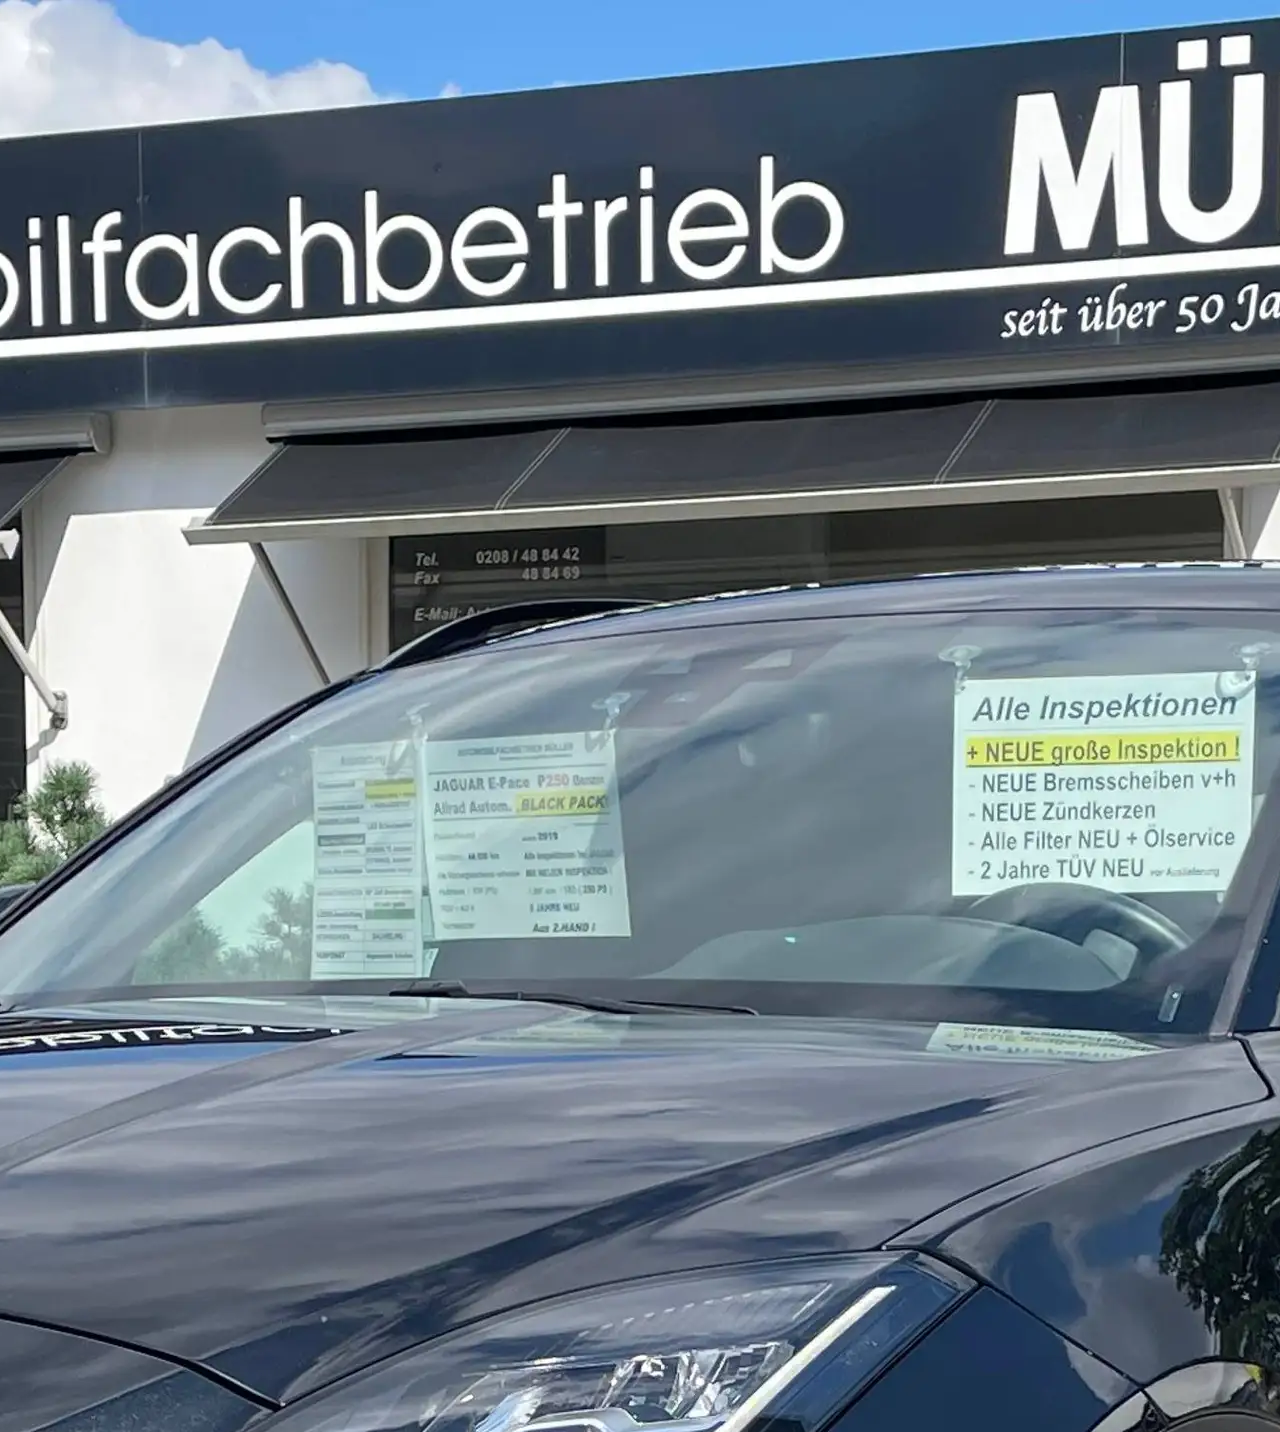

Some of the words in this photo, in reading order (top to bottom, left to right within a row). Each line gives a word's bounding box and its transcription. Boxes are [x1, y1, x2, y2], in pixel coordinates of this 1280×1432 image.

[1001, 300, 1066, 340] seit
[1077, 284, 1165, 335] über
[1174, 291, 1225, 334] 50
[415, 552, 440, 567] Tel.
[476, 550, 510, 565] 0208
[521, 549, 538, 562] 48
[542, 548, 559, 561] 84
[562, 547, 580, 561] 42
[414, 571, 440, 585] Fax
[522, 568, 538, 581] 48
[563, 566, 581, 580] 69
[972, 695, 1031, 722] Alle
[1039, 691, 1238, 726] Inspektionen
[985, 740, 1045, 763] NEUE
[1050, 738, 1111, 767] große
[1117, 735, 1227, 764] Inspektion
[433, 776, 486, 792] JAGUAR
[982, 772, 1037, 793] NEUE
[1043, 770, 1194, 792] Bremsscheiben
[1201, 768, 1236, 789] v+h
[981, 802, 1037, 822] NEUE
[1042, 800, 1156, 822] Zündkerzen
[980, 830, 1017, 851] Alle
[1023, 829, 1072, 851] Filter
[1077, 828, 1120, 849] NEU
[1143, 823, 1236, 849] Ölservice
[980, 861, 991, 880] 2
[996, 859, 1050, 880] Jahre
[1056, 853, 1097, 878] TÜV
[1101, 858, 1145, 878] NEU
